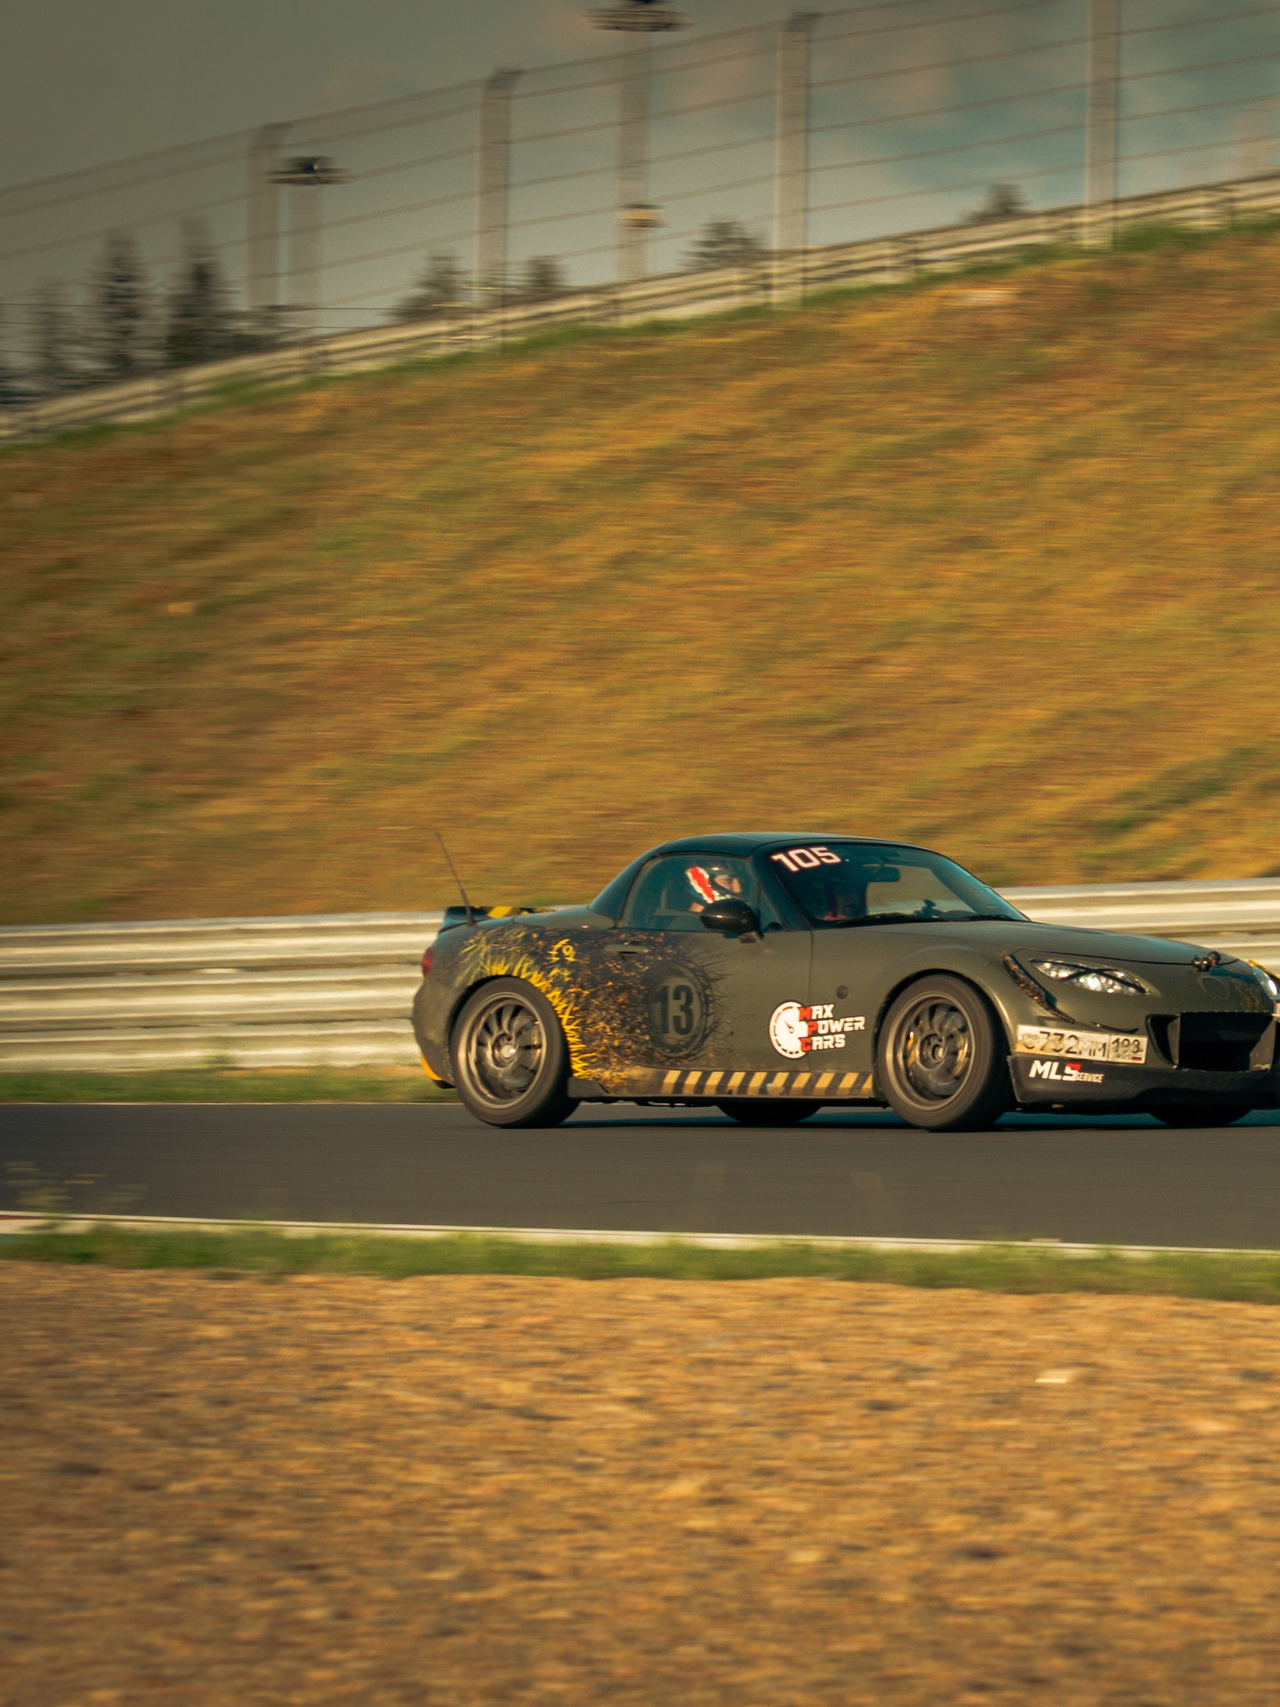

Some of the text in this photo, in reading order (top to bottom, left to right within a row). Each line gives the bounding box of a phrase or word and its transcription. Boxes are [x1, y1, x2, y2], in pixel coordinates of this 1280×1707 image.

[771, 846, 842, 873] 105
[655, 984, 694, 1035] 13
[798, 1004, 834, 1021] MAX
[807, 1016, 866, 1035] POWER
[800, 1034, 846, 1052] CARS
